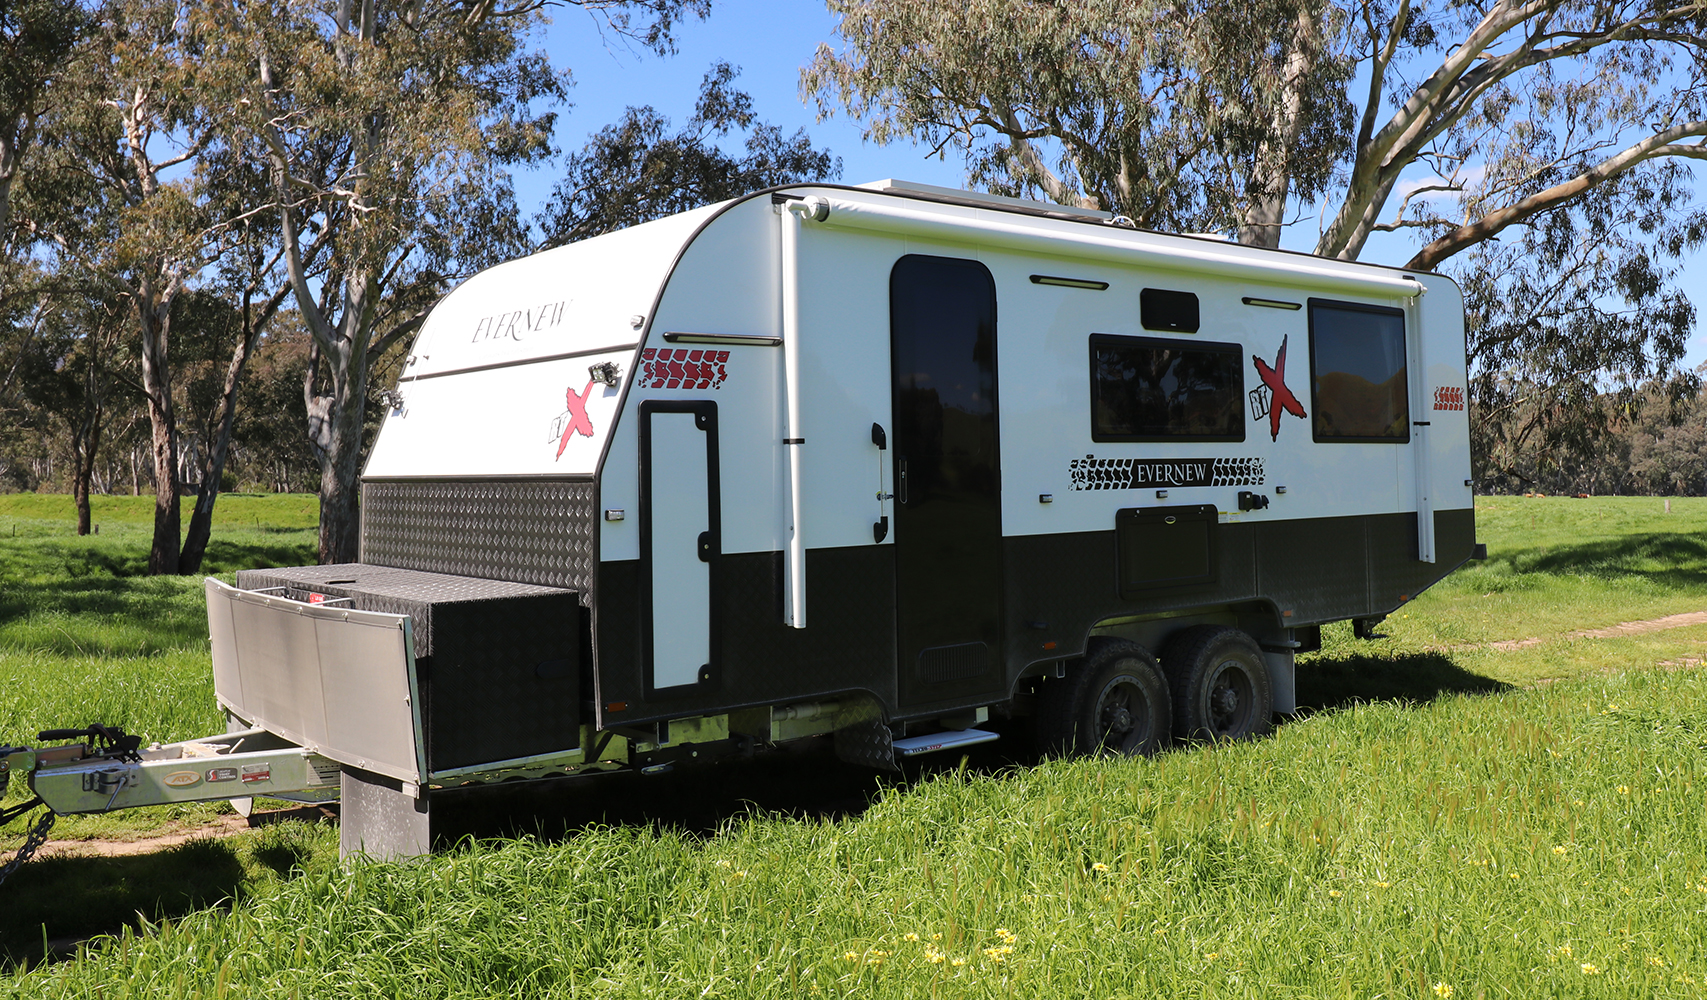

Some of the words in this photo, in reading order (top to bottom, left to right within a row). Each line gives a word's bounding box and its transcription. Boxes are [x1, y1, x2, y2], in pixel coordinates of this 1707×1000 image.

[471, 299, 573, 343] EVERNEW
[1137, 463, 1207, 486] EVERNEW
[171, 774, 194, 784] ATX
